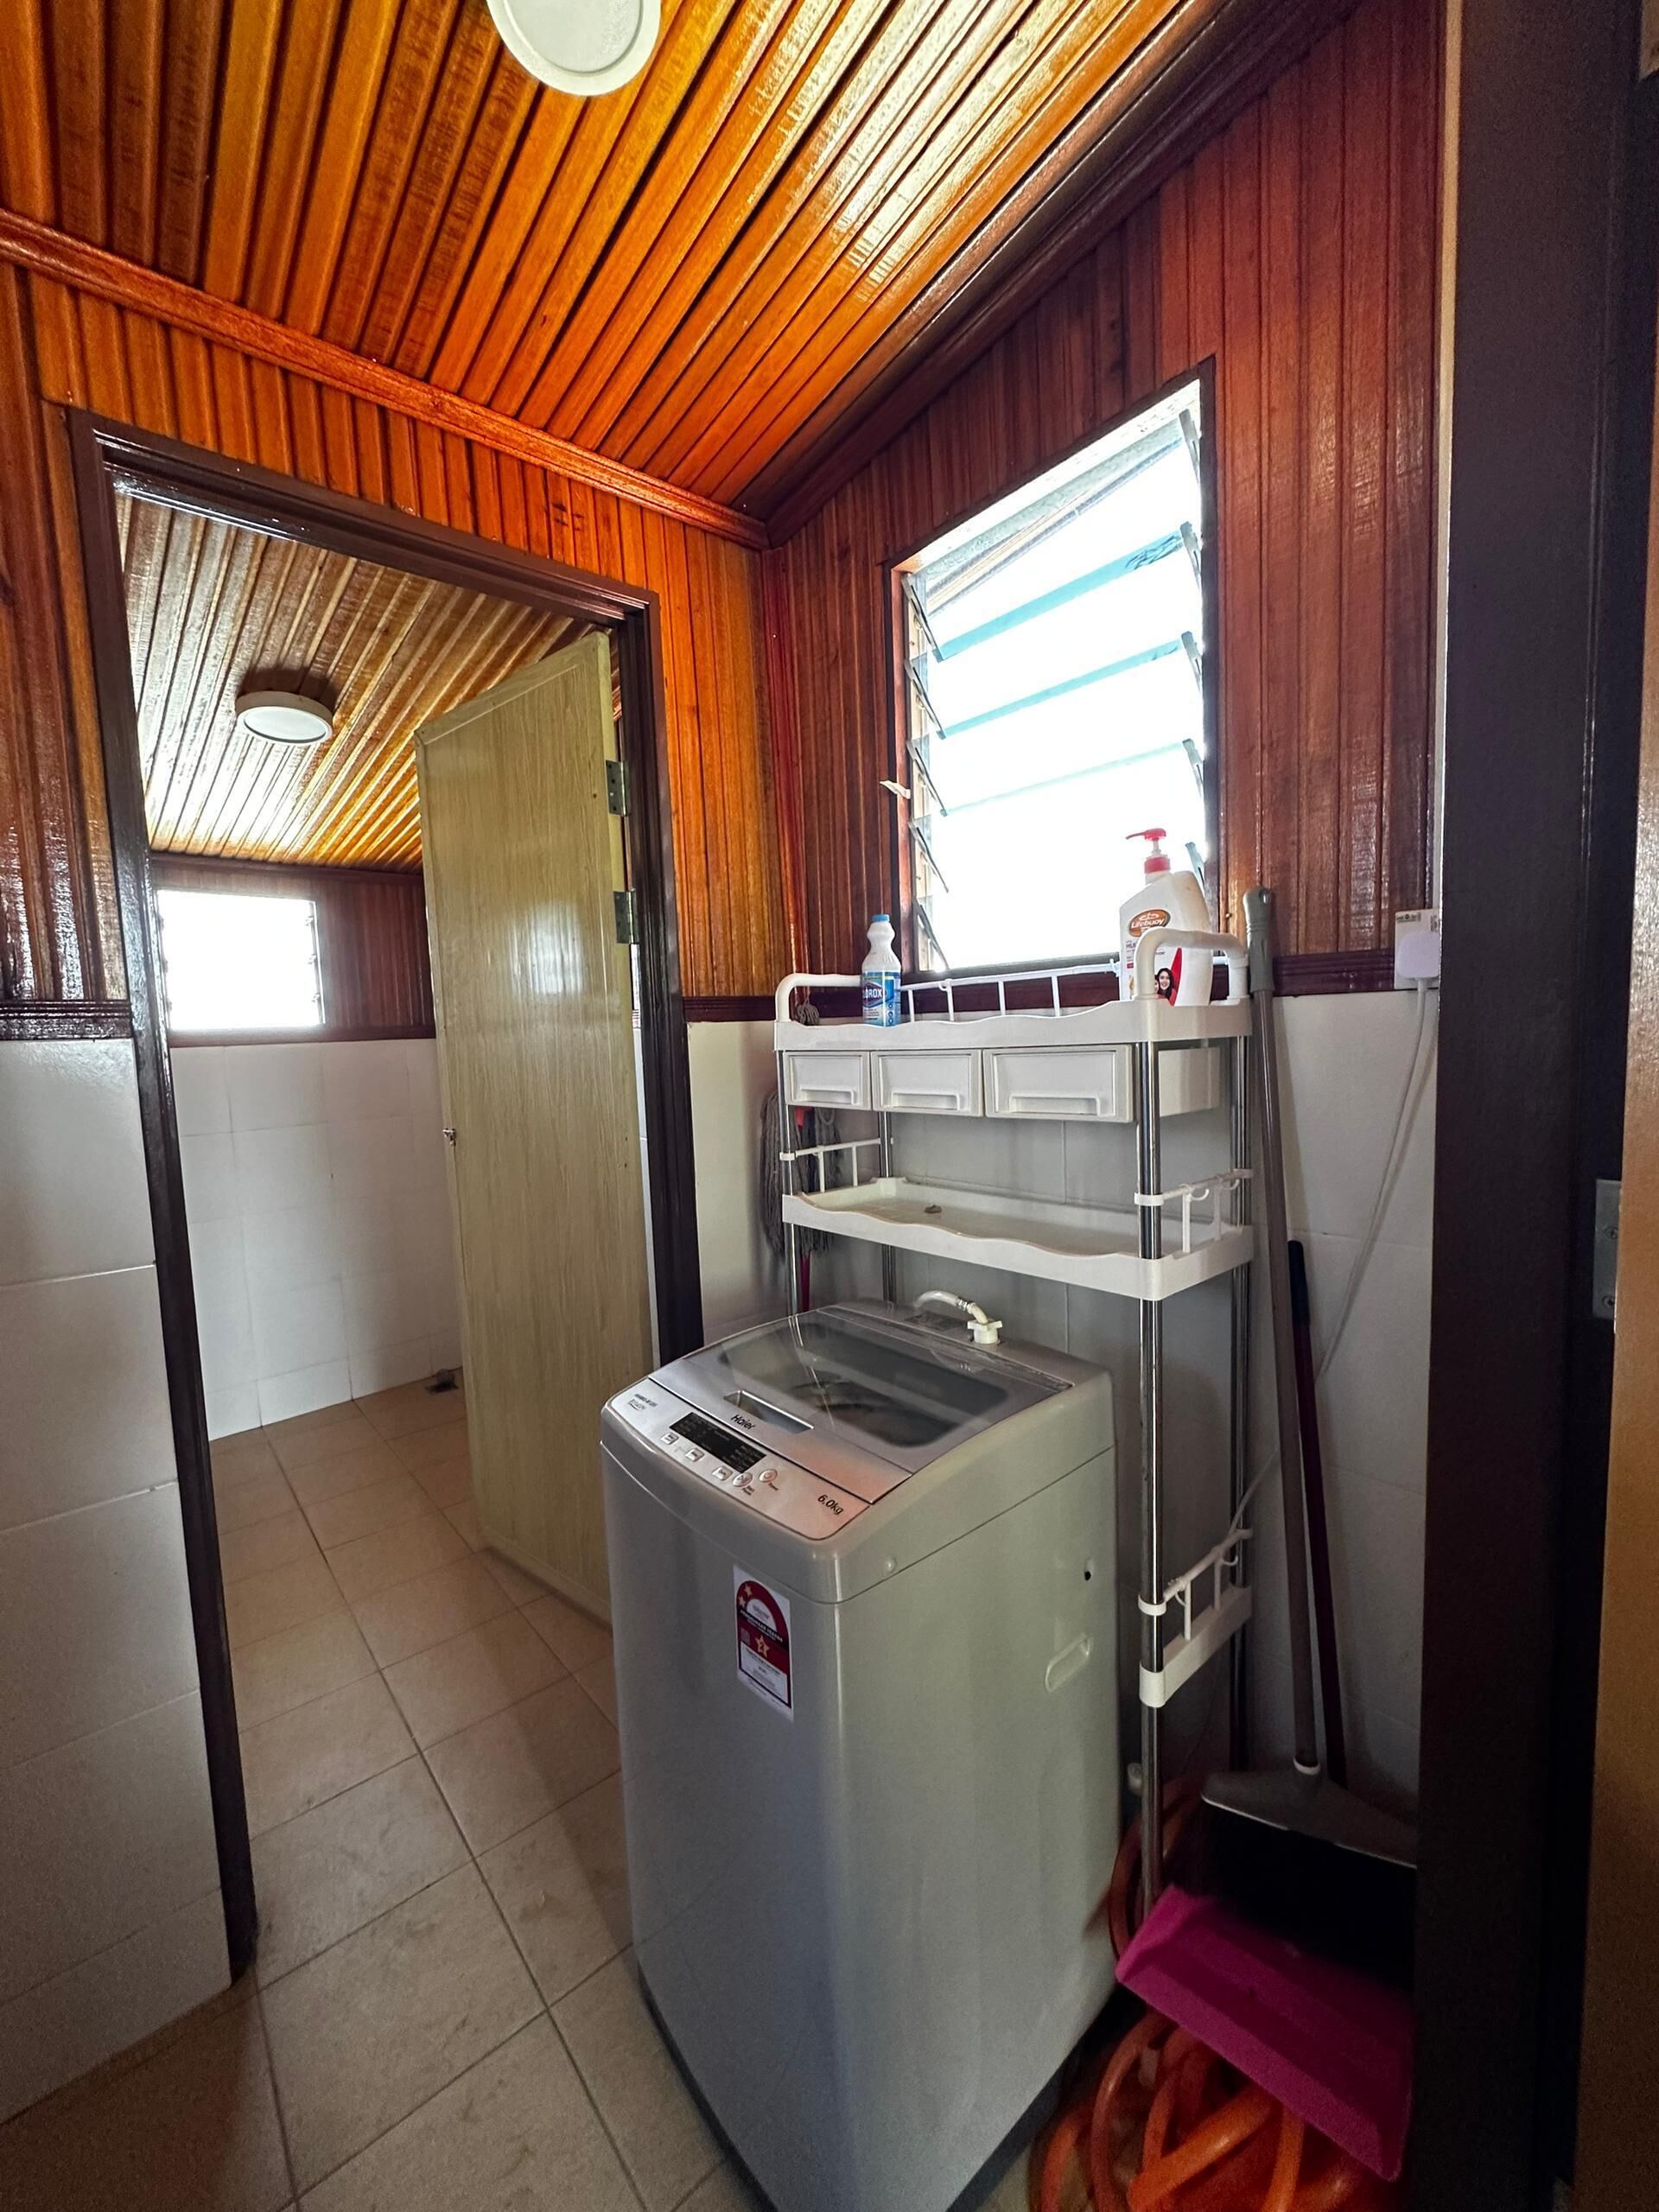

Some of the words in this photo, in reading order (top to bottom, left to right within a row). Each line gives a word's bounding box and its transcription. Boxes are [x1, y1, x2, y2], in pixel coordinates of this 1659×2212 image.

[1131, 918, 1165, 929] Lifebuoy
[862, 988, 882, 998] LOROX
[731, 1414, 756, 1429] Haier
[817, 1494, 844, 1516] 6.0kg
